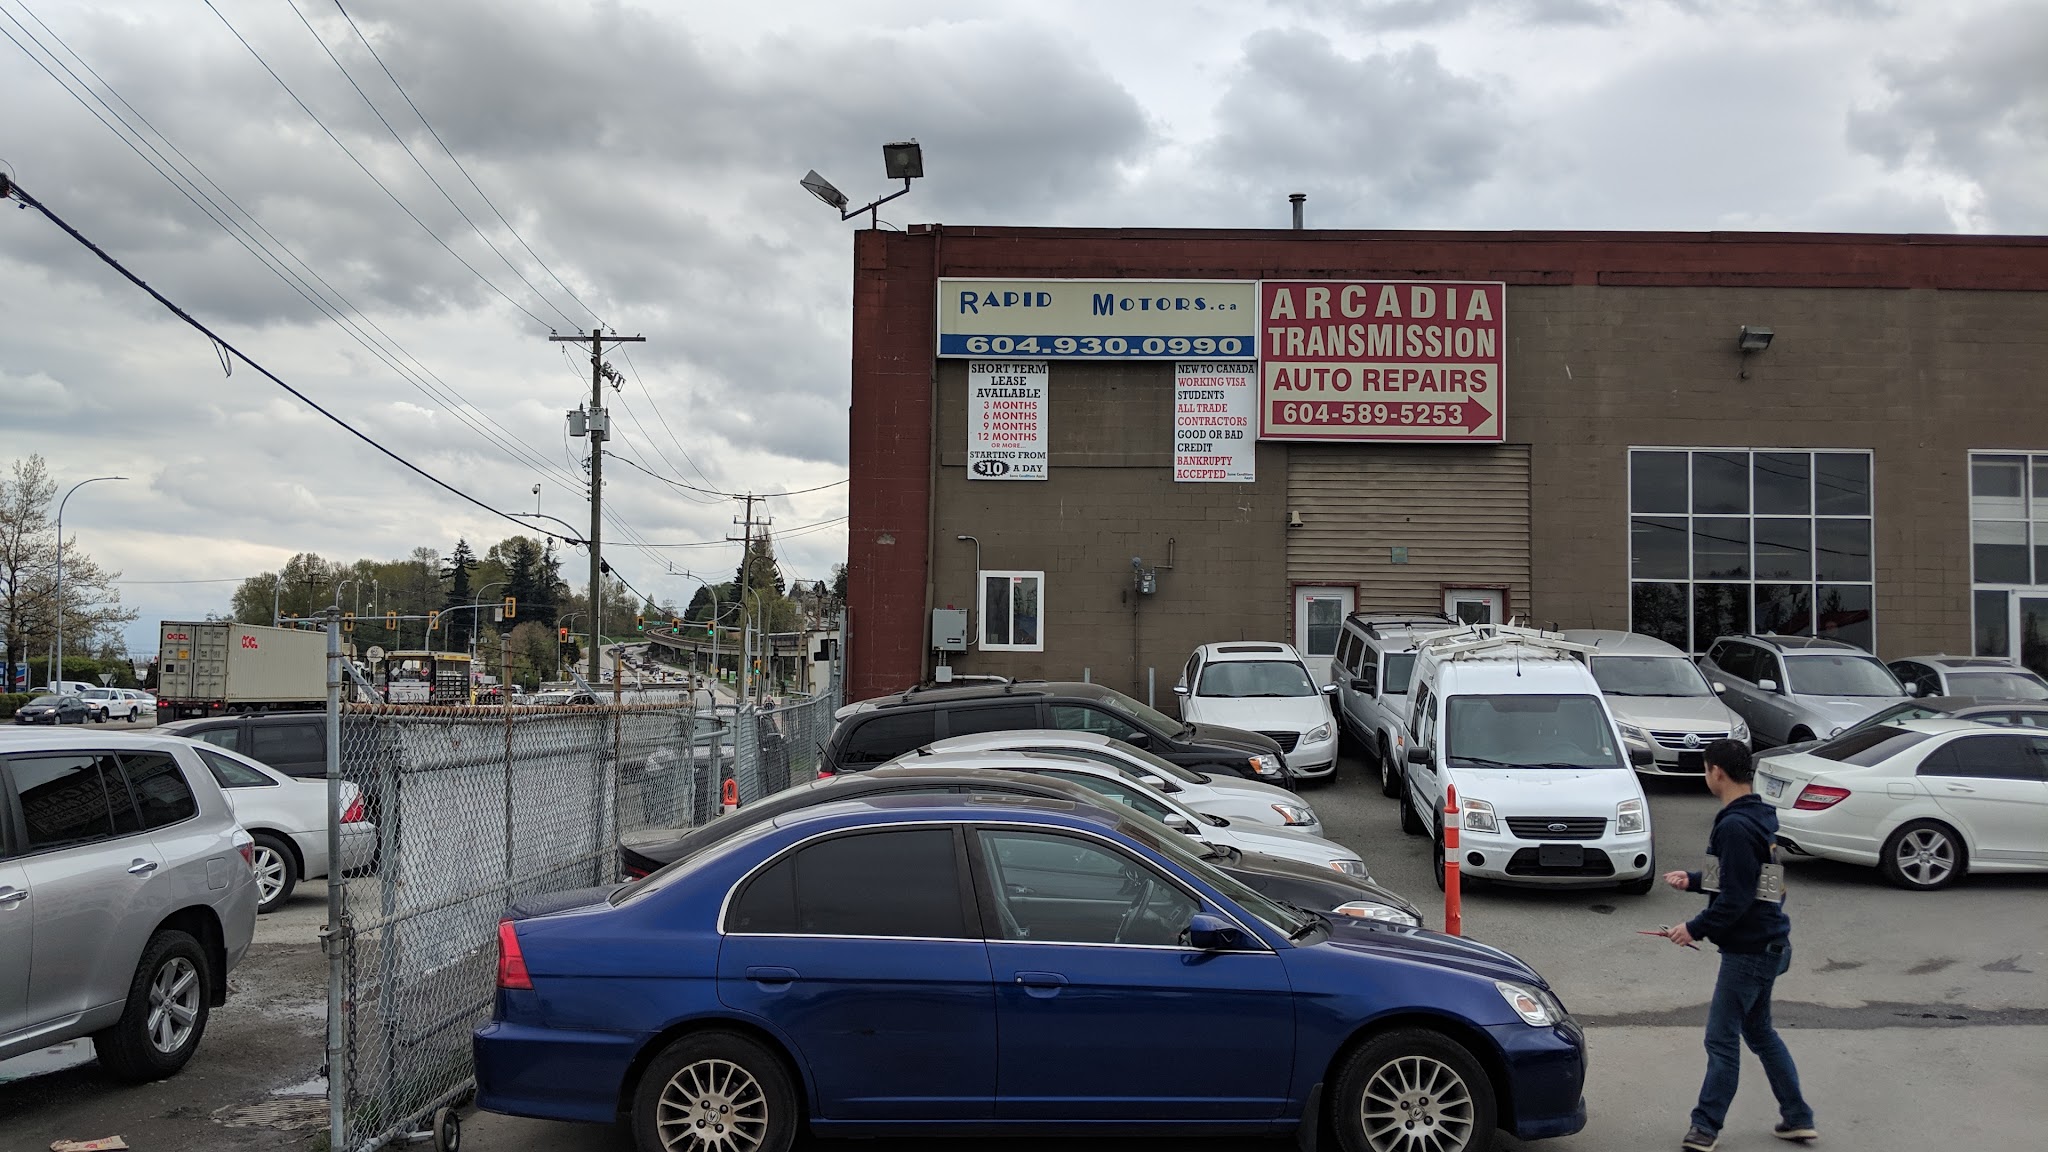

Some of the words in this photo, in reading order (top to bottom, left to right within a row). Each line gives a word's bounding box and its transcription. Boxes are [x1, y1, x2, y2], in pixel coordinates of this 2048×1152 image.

[960, 290, 1052, 314] RAPID
[1269, 285, 1493, 321] ARCADIA
[966, 336, 1242, 354] 604.930.0990
[1268, 324, 1496, 358] TRANSMISSION
[971, 363, 1010, 374] SHORT
[1012, 363, 1047, 374] TERM
[1178, 364, 1200, 374] NEW
[1201, 364, 1214, 374] TO
[1216, 364, 1254, 374] CANADA
[991, 376, 1027, 386] LEASE
[1178, 377, 1225, 387] WORKING
[1226, 377, 1246, 387] VISA
[1273, 368, 1352, 392] AUTO
[1362, 369, 1488, 393] REPAIRS
[976, 388, 1041, 398] AVAILABLE
[1178, 390, 1225, 400] STUDENTS
[983, 401, 990, 410] 3
[992, 401, 1038, 410] MONTHS
[1178, 403, 1195, 413] ALL
[1196, 403, 1228, 413] TRADE
[983, 412, 990, 420] 6
[992, 412, 1038, 420] MONTHS
[1283, 404, 1463, 424] 604-589-5253
[1177, 416, 1248, 426] CONTRACTORS
[983, 422, 990, 431] 9
[992, 422, 1038, 431] MONTHS
[977, 432, 990, 441] 12
[992, 432, 1037, 441] MONTHS
[1178, 430, 1206, 439] GOOD
[1208, 430, 1223, 439] OR
[1224, 430, 1244, 440] BAD
[1178, 443, 1213, 453] CREDIT
[969, 451, 1016, 459] STARTING
[1018, 451, 1047, 459] FROM
[1177, 456, 1233, 466] BANKRUPTY
[978, 461, 1004, 475] $10
[1177, 469, 1226, 479] ACCEPTED
